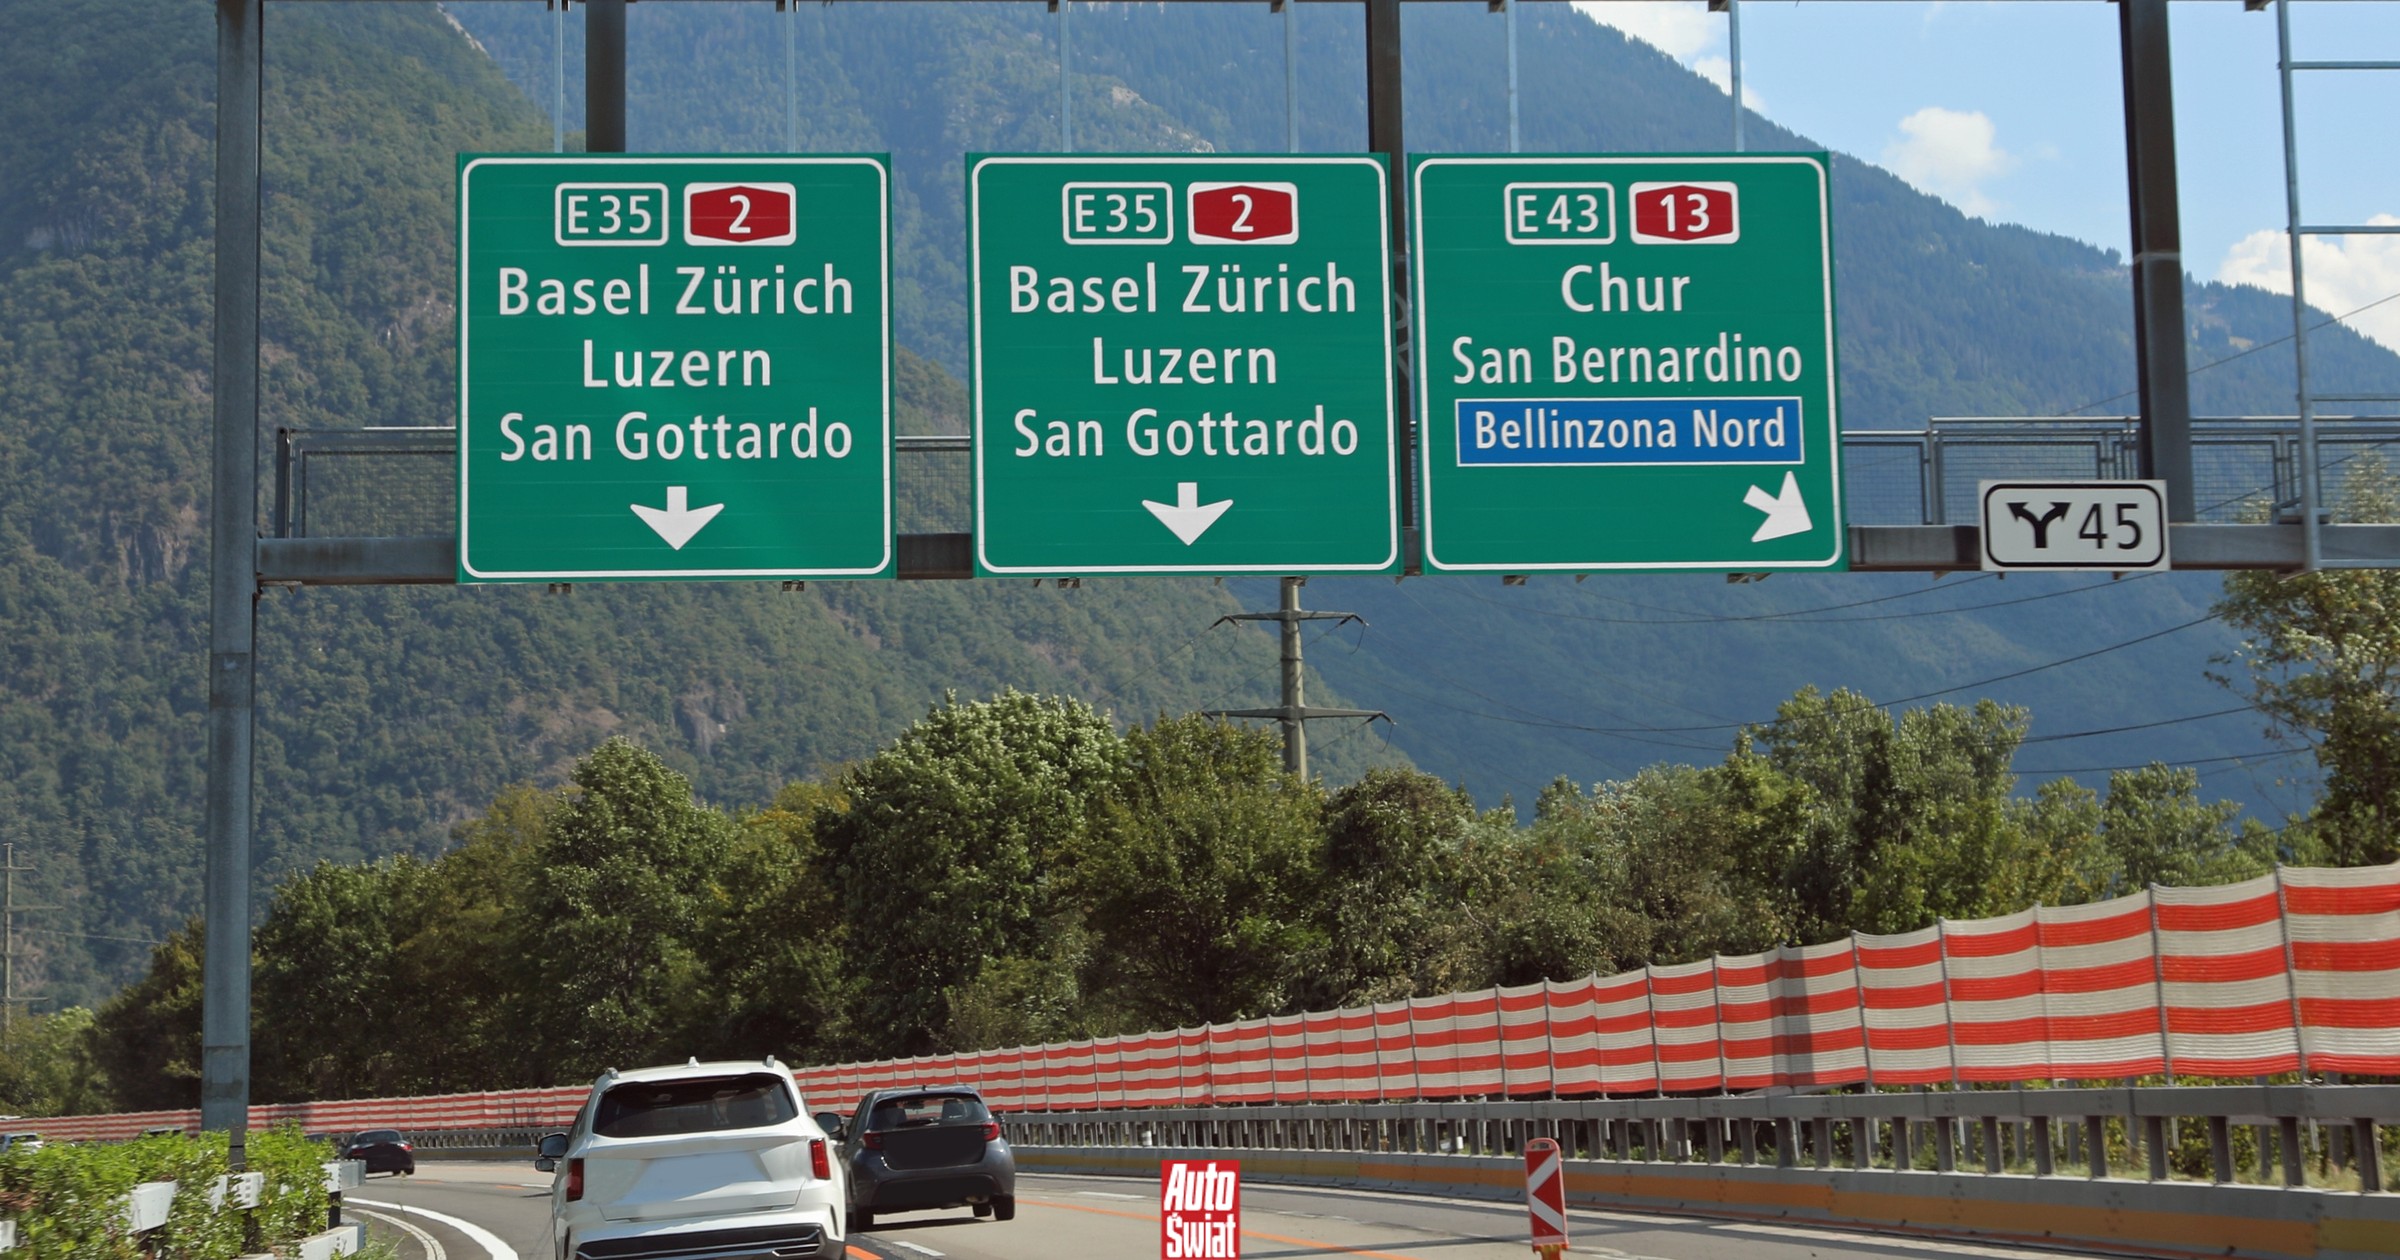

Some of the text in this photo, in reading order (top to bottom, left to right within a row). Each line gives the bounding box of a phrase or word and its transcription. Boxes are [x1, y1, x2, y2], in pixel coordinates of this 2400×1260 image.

[729, 195, 751, 233] 2
[1230, 193, 1255, 232] 2
[1661, 194, 1709, 232] 13
[500, 264, 852, 315] Basel Zürich
[1011, 262, 1355, 313] Basel Zürich
[1562, 262, 1690, 312] Chur
[584, 340, 770, 387] Luzern
[1094, 337, 1276, 384] Luzern
[1453, 332, 1801, 384] San Bernardino
[501, 407, 851, 461] San Gottardo
[1015, 405, 1357, 457] San Gottardo
[1476, 407, 1784, 448] Bellinzona Nord
[2079, 503, 2141, 549] 45
